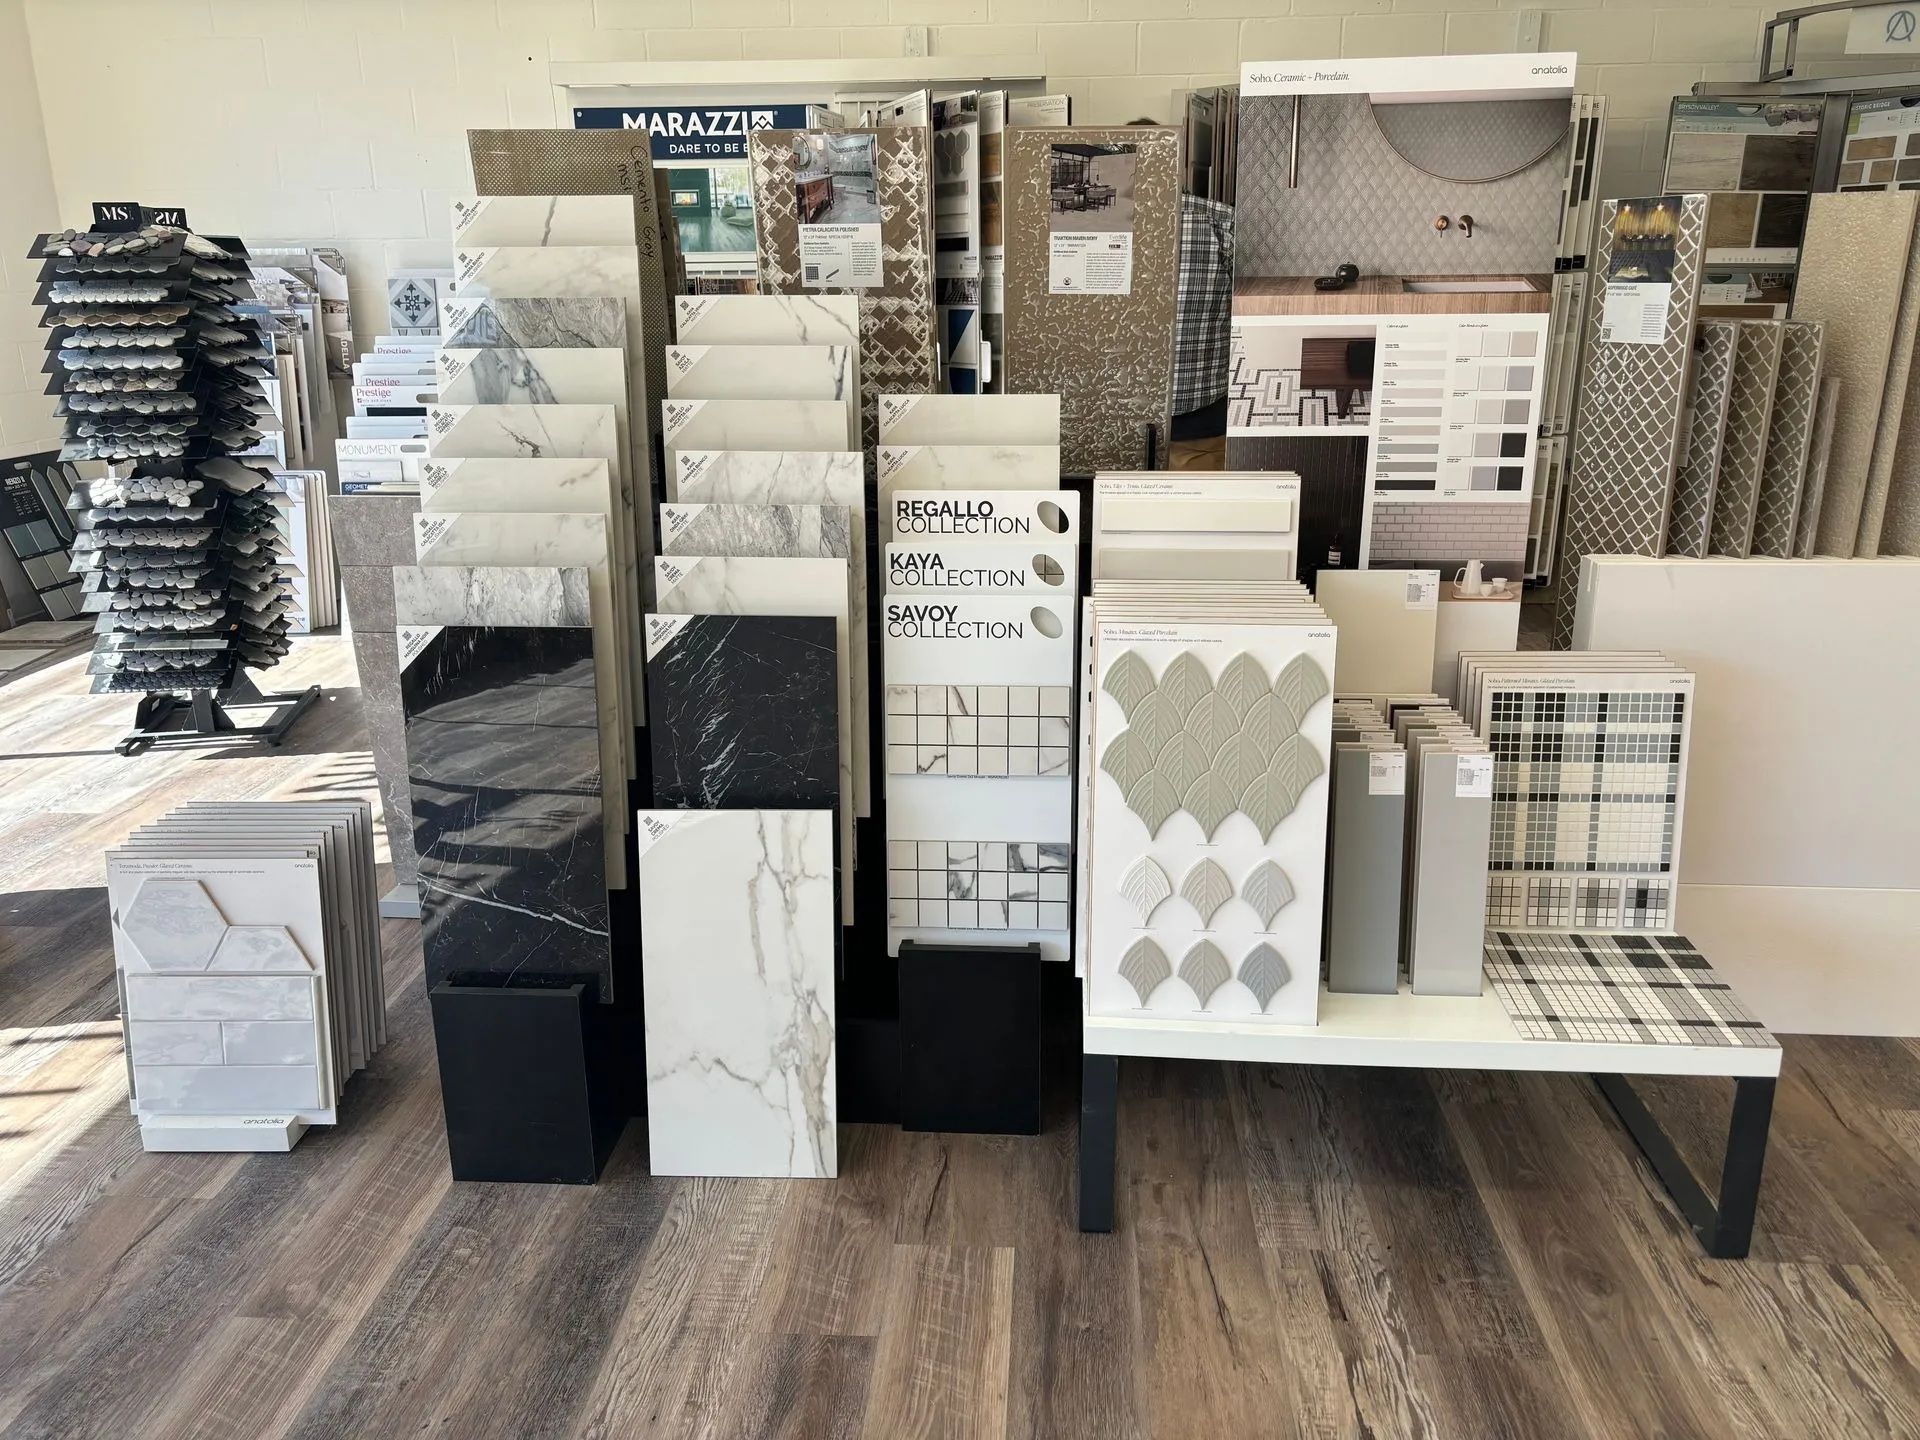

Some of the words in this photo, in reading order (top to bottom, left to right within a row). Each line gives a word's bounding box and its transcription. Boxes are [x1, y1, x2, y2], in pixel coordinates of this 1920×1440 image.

[1273, 73, 1306, 82] Ceramic
[1531, 64, 1568, 75] anatolia
[622, 111, 748, 137] MARAZZI
[669, 143, 701, 154] DARE
[705, 143, 720, 153] TO
[724, 143, 739, 153] BE
[630, 145, 652, 213] Cemento
[640, 226, 656, 258] Gray
[365, 378, 401, 386] Prestige
[356, 388, 392, 399] Prestige
[668, 406, 685, 423] REGALLO
[338, 444, 398, 455] MONUMENT
[897, 500, 994, 517] REGALLO
[422, 520, 438, 538] REGALLO
[896, 517, 1030, 533] COLLECTION
[428, 526, 446, 545] POLISHED
[890, 553, 945, 570] KAYA
[890, 569, 1025, 586] COLLECTION
[887, 605, 958, 622] SAVOY
[652, 621, 668, 638] REGALLO
[887, 621, 1023, 638] COLLECTION
[405, 633, 421, 650] REGALLO
[412, 639, 429, 657] POLISHED
